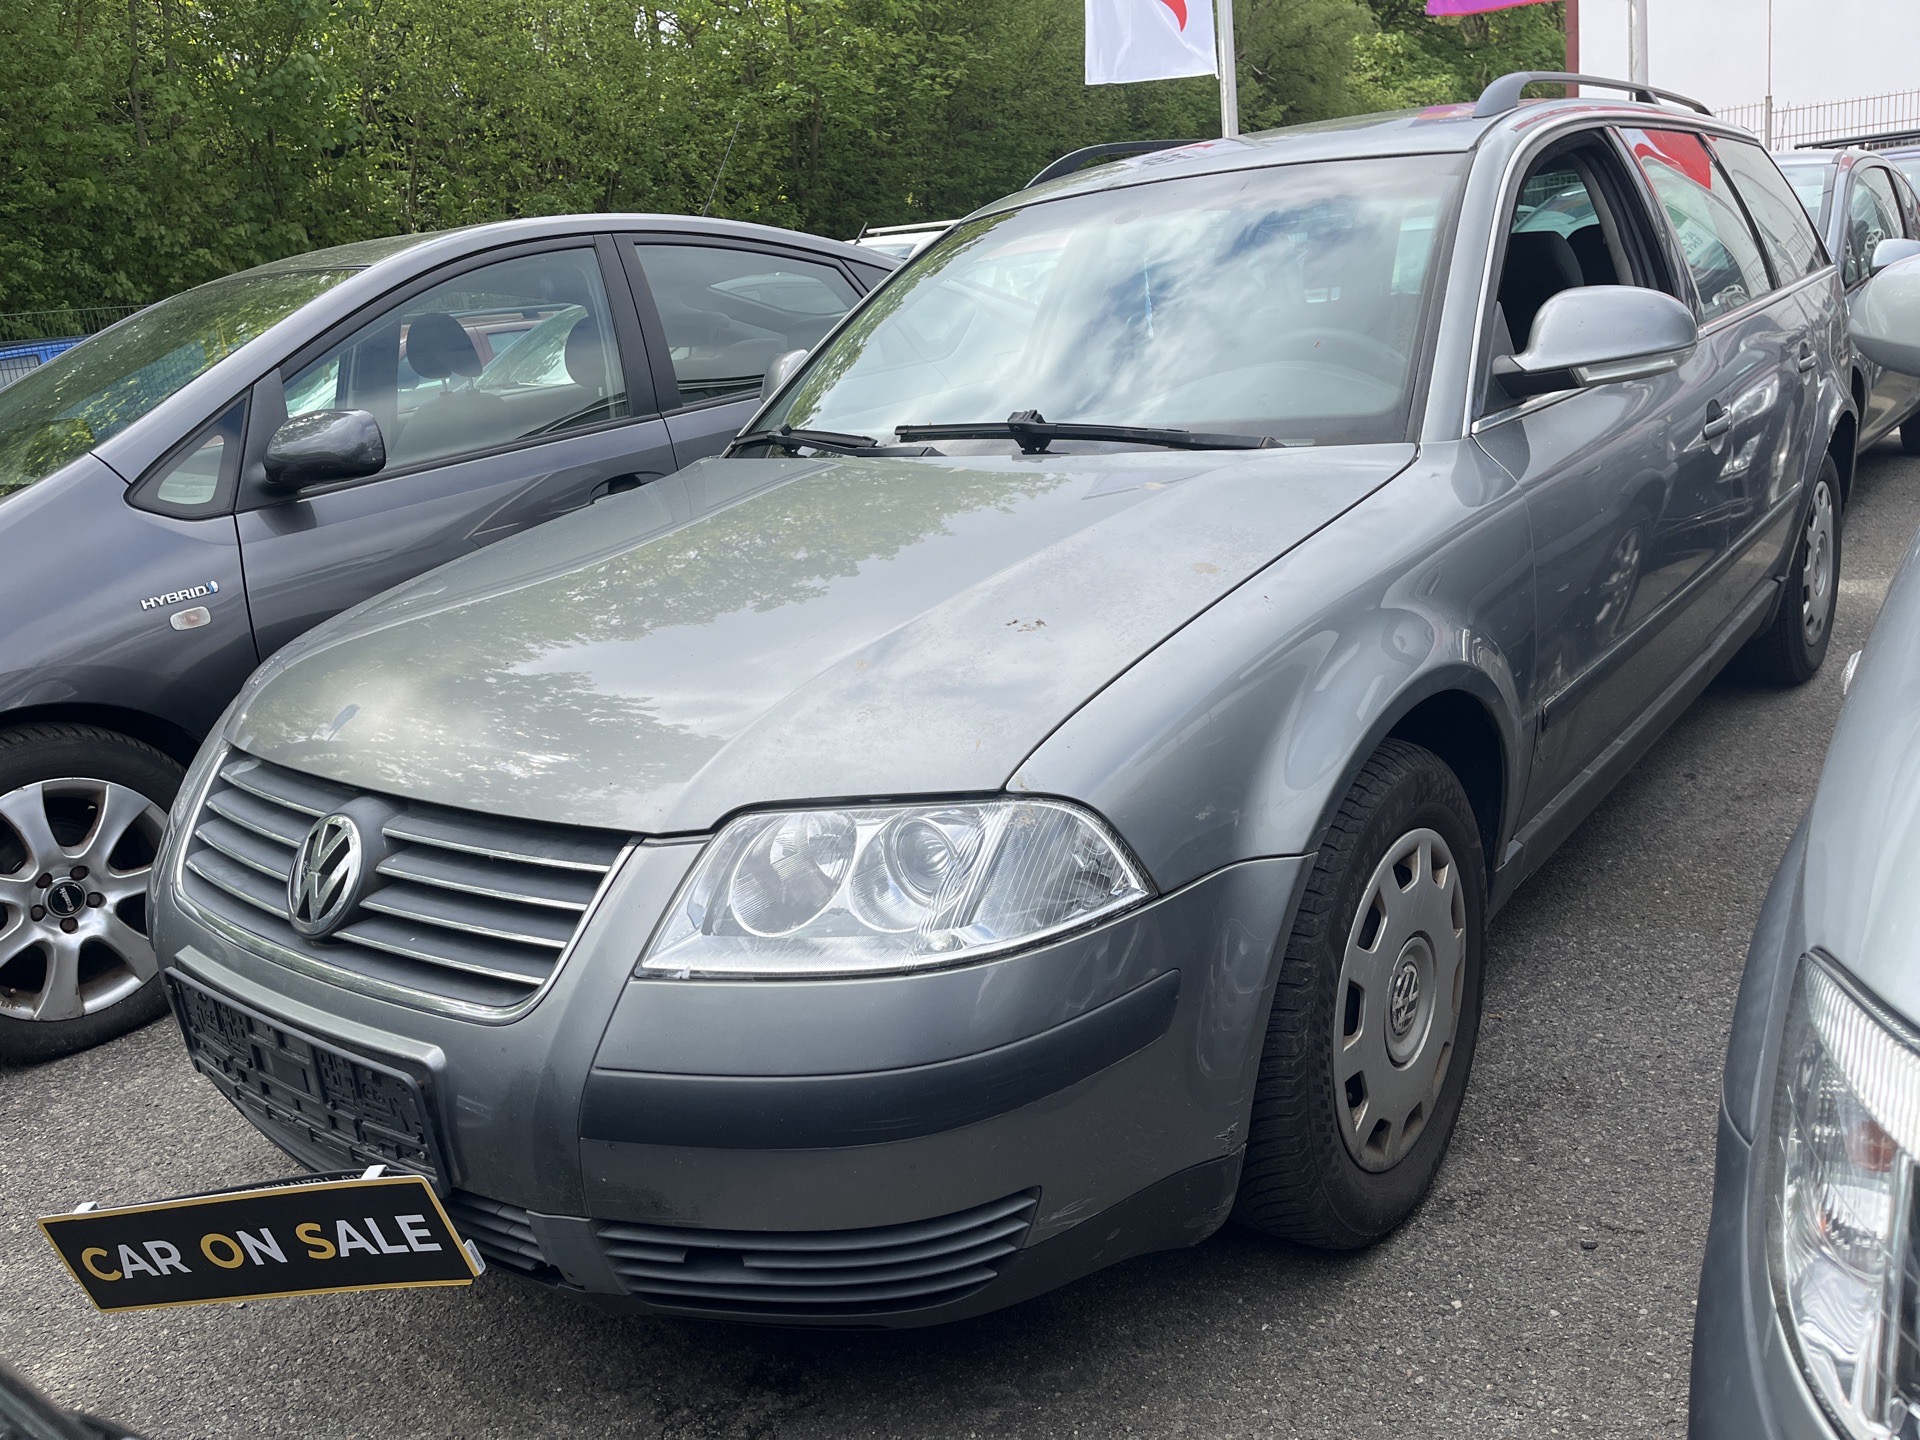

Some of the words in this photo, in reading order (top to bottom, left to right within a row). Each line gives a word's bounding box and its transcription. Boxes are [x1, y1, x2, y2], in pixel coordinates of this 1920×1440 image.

[140, 585, 210, 611] HYBRID
[290, 814, 361, 934] VW
[81, 1240, 193, 1281] CAR
[200, 1227, 288, 1268] ON
[295, 1214, 443, 1260] SALE
